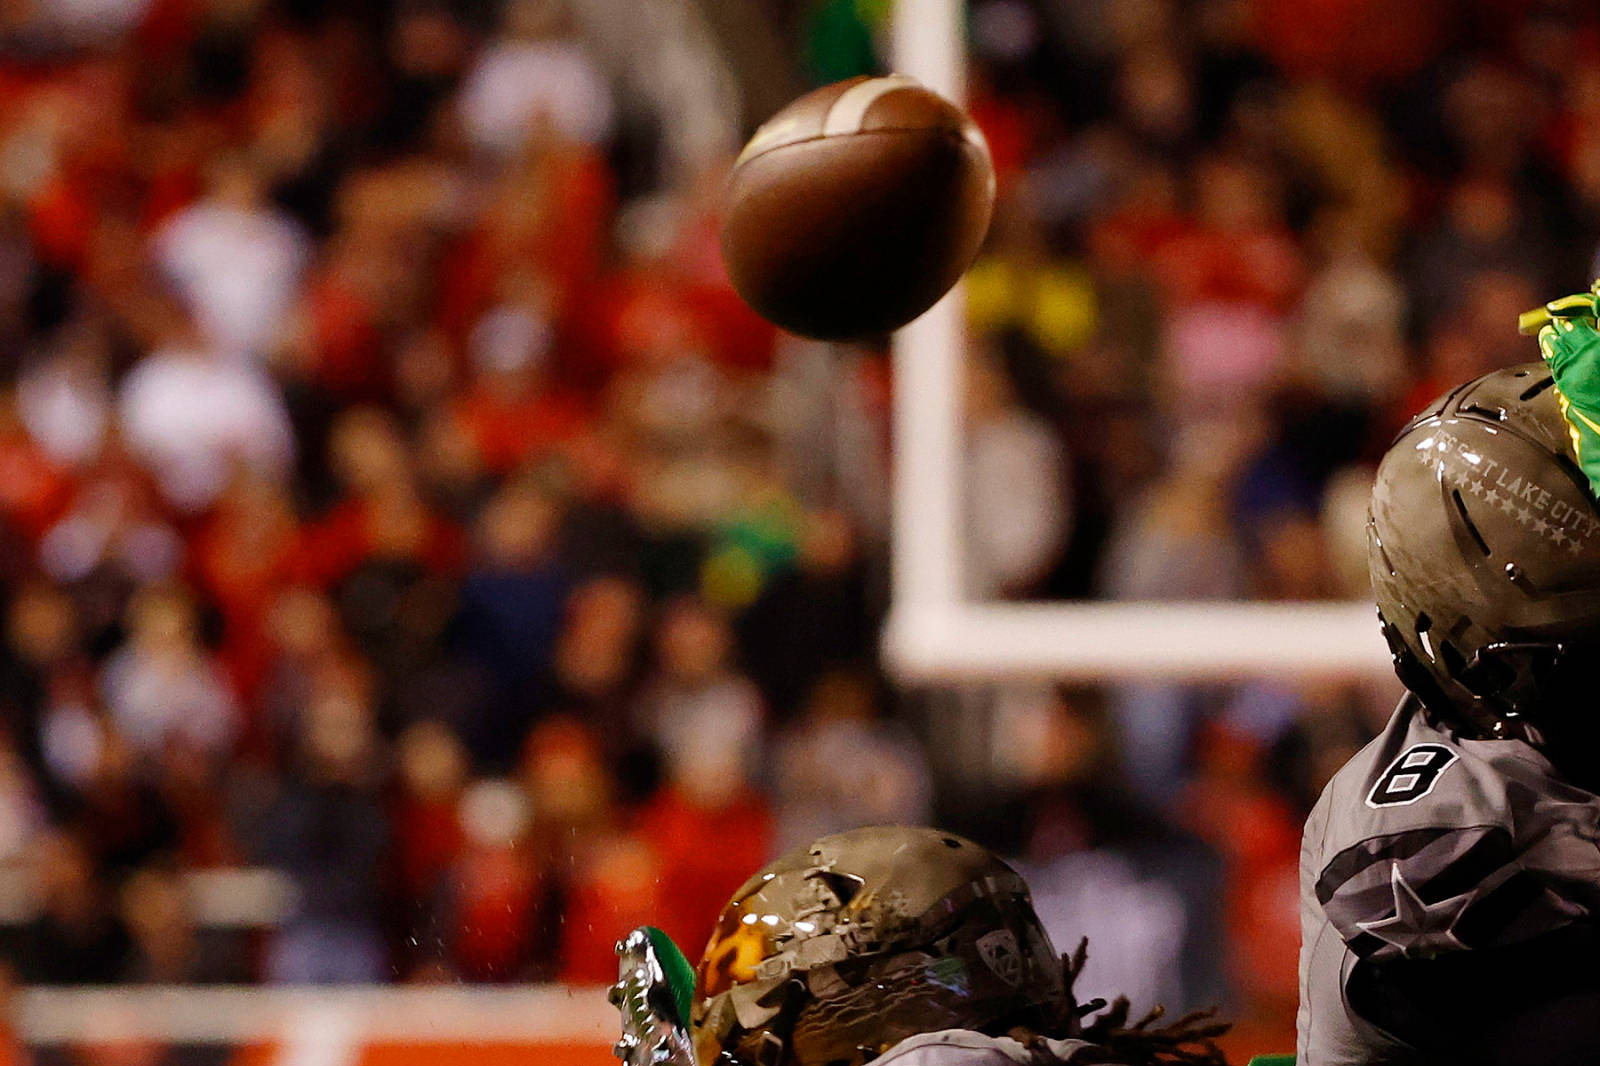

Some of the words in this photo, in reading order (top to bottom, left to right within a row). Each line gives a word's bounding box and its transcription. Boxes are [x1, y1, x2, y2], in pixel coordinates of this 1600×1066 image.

[1495, 467, 1552, 512] LAKE
[1549, 499, 1600, 538] CITY
[1364, 743, 1461, 809] 8
